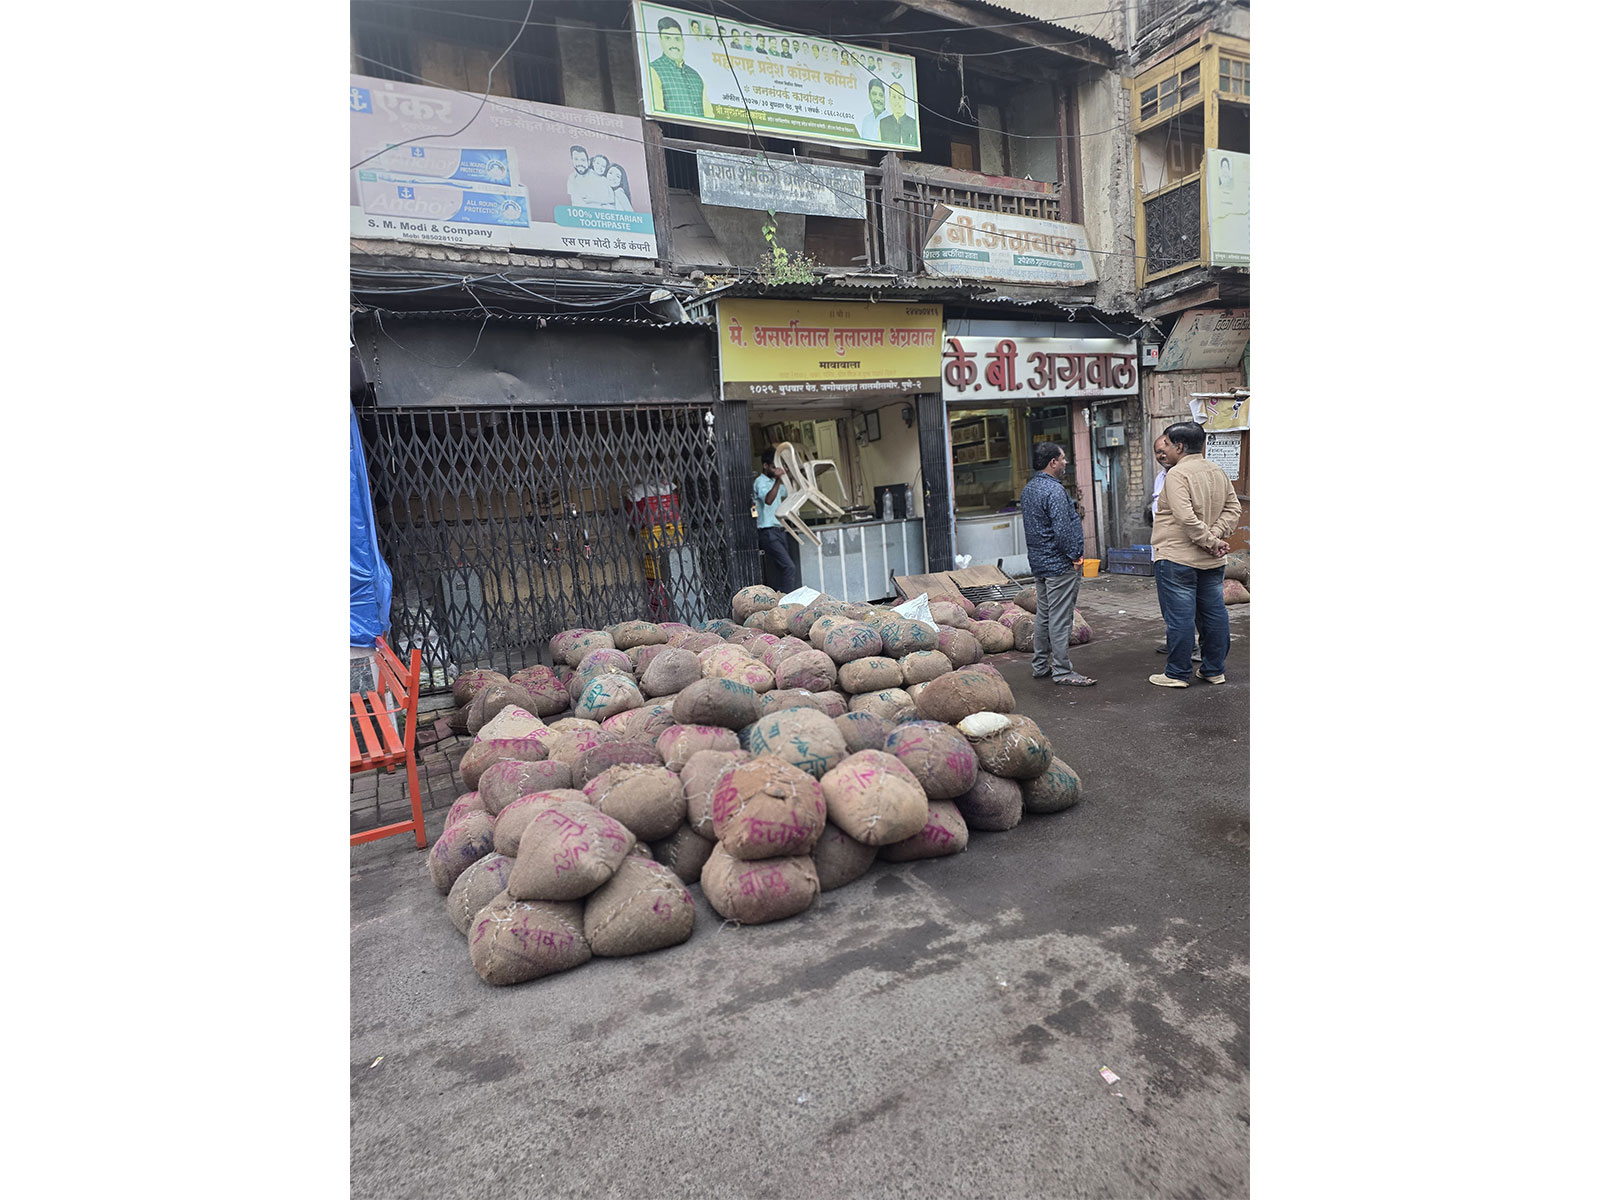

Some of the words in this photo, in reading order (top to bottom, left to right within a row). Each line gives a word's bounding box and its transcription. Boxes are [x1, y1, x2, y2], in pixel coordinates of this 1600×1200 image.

[757, 57, 784, 79] प्रदेश
[823, 69, 857, 90] कमिटी
[752, 85, 790, 101] जनसंपर्क
[792, 89, 826, 106] कार्यालय
[464, 206, 499, 215] PROTECTION
[567, 208, 593, 219] 100%
[594, 212, 643, 224] VEGETARIAN
[367, 219, 379, 228] S.
[383, 220, 397, 229] M.
[400, 221, 428, 232] Modi
[431, 224, 440, 232] &
[443, 225, 493, 238] Company
[580, 219, 631, 231] TOOTHPASTE
[561, 237, 576, 247] एस
[577, 238, 591, 248] एम
[592, 237, 611, 249] मोदी
[628, 241, 651, 252] कंपनी
[728, 316, 748, 347] मे.
[833, 328, 885, 357] तुलाराम
[887, 327, 937, 348] अग्रवाल
[818, 360, 861, 369] मावावाला
[943, 338, 982, 392] के.
[985, 339, 1023, 392] बी.
[1027, 351, 1137, 391] अग्रवाल
[778, 384, 804, 395] बुधवार
